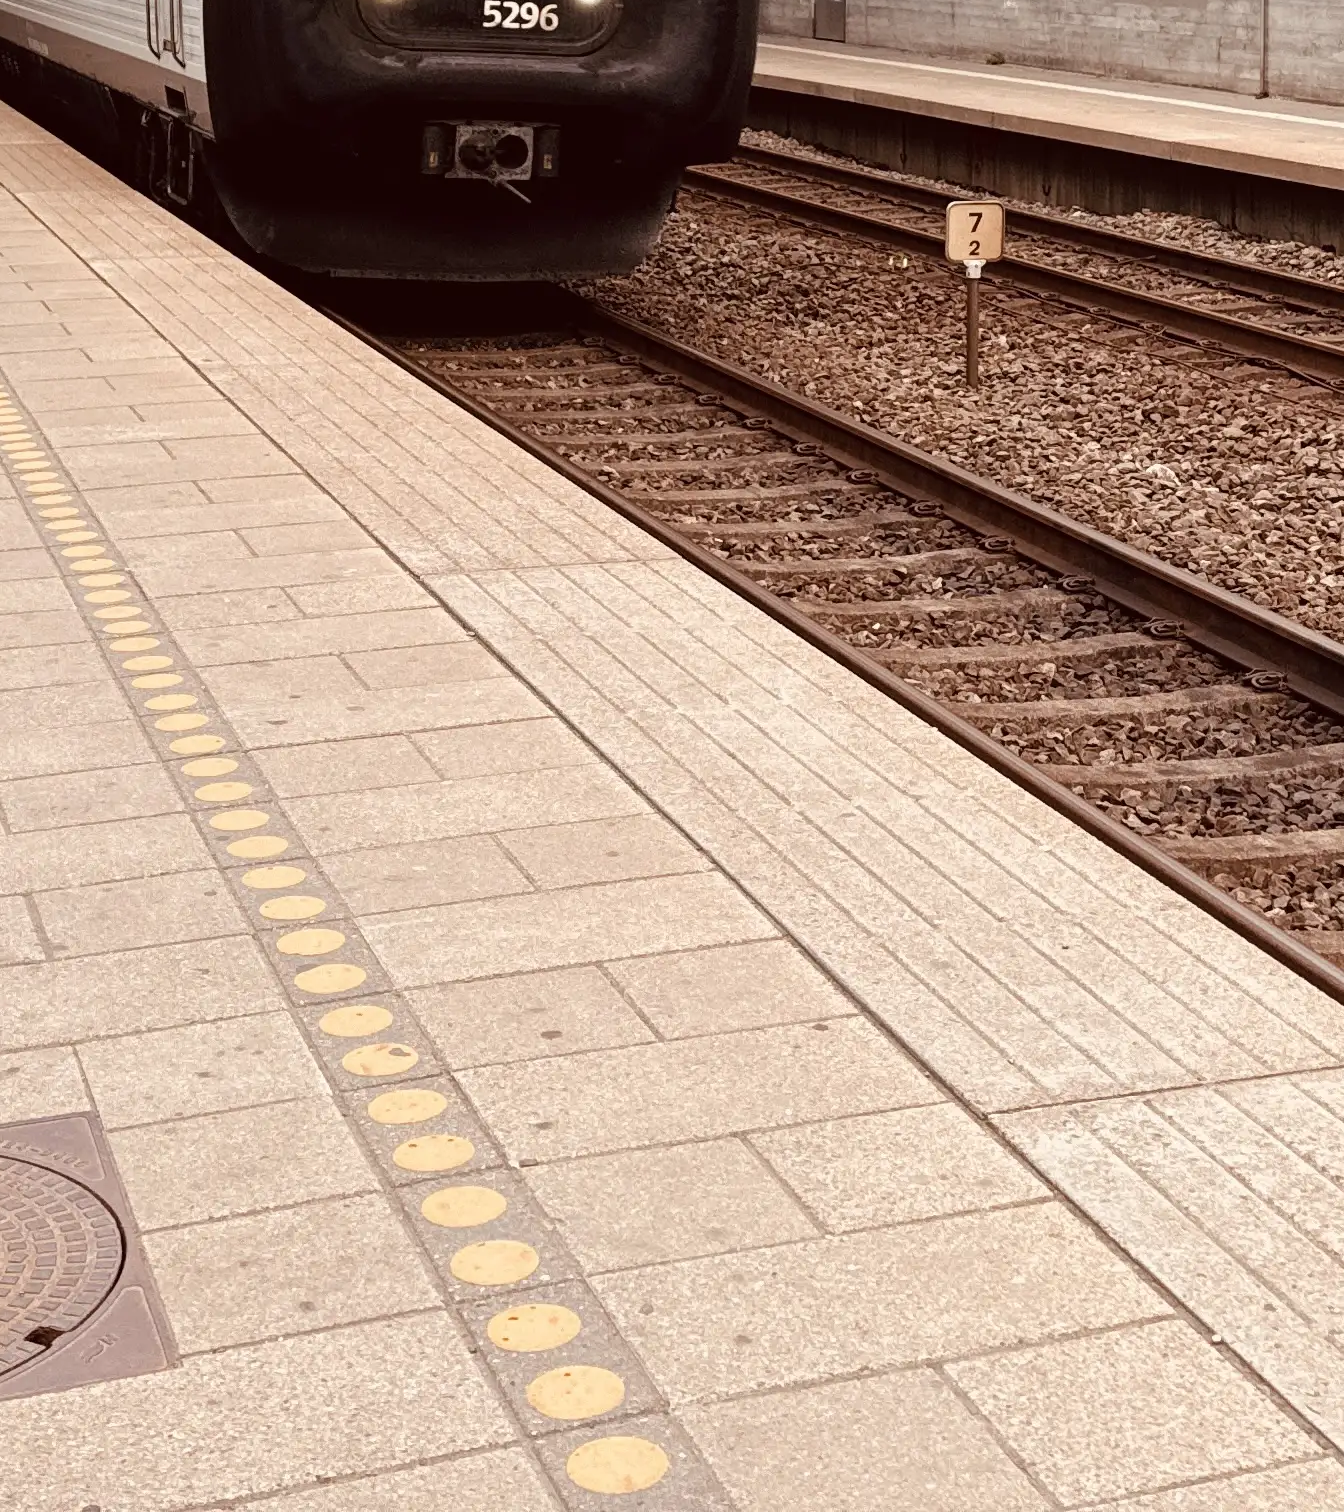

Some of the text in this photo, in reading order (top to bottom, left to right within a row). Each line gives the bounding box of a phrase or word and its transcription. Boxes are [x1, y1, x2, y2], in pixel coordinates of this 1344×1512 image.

[482, 0, 559, 32] 5296
[968, 212, 983, 233] 7
[968, 240, 981, 256] 2
